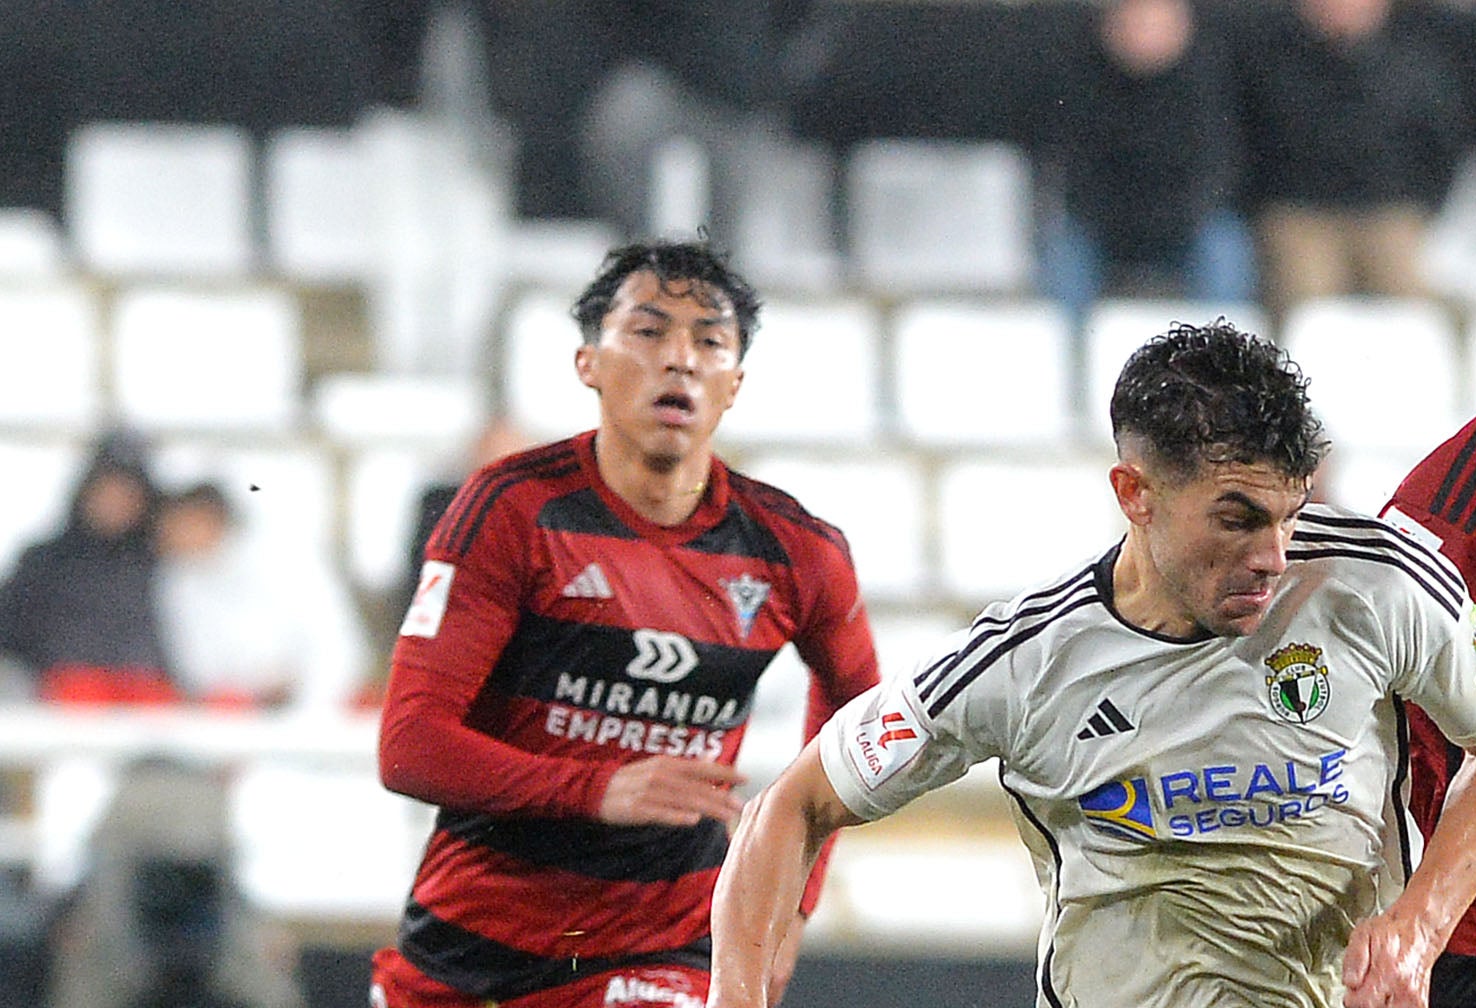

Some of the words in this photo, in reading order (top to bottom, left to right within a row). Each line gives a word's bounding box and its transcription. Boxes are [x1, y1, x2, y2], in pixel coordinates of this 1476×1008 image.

[546, 705, 726, 763] EMPRESAS
[856, 732, 883, 776] LALIGA
[1160, 749, 1346, 810] REALE
[1168, 784, 1350, 838] SEGUROS
